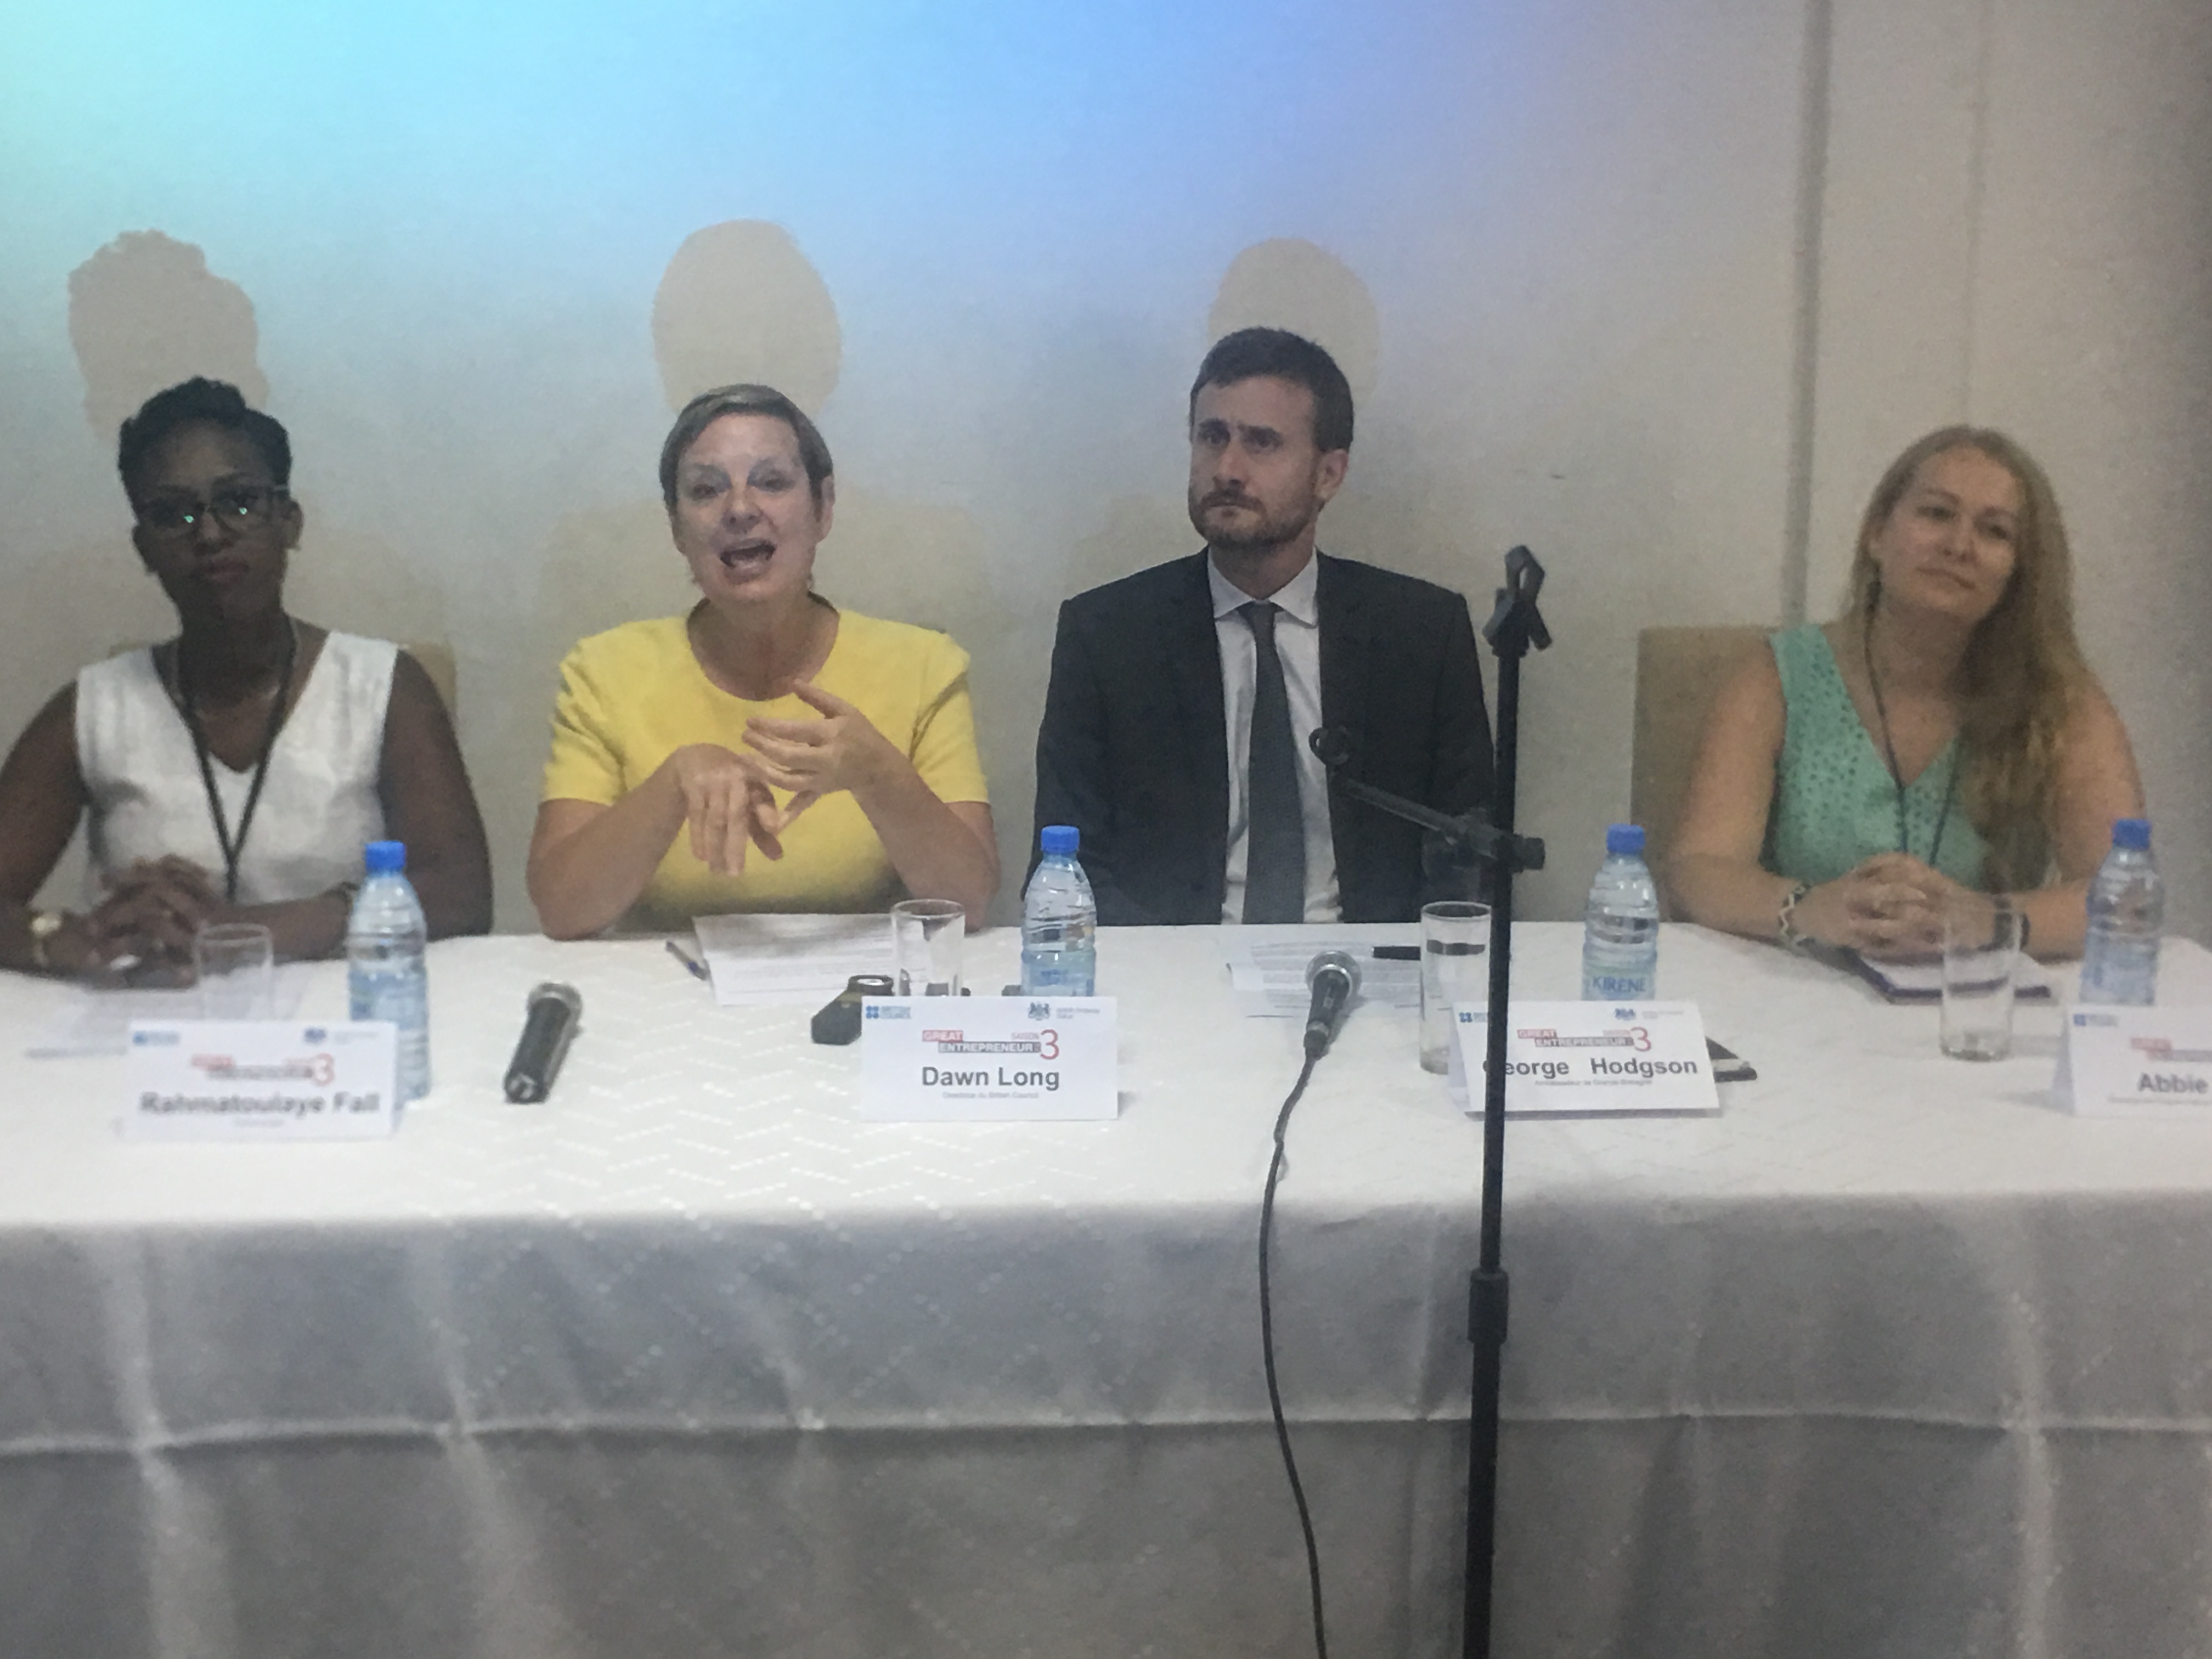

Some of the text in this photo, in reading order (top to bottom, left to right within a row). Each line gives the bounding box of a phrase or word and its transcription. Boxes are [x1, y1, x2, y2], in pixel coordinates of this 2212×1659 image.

[923, 1030, 963, 1041] GREAT
[1040, 1029, 1060, 1060] 3
[1517, 1029, 1556, 1039] GREAT
[1536, 1037, 1627, 1047] ENTREPRENEUR
[1630, 1026, 1652, 1052] 3
[940, 1042, 1034, 1053] ENTREPRENEUR
[312, 1052, 335, 1086] 3
[922, 1066, 1059, 1091] Dawn Long
[1482, 1057, 1698, 1079] eorge Hodgson
[2137, 1072, 2209, 1094] Abbie
[332, 1091, 380, 1114] Fall
